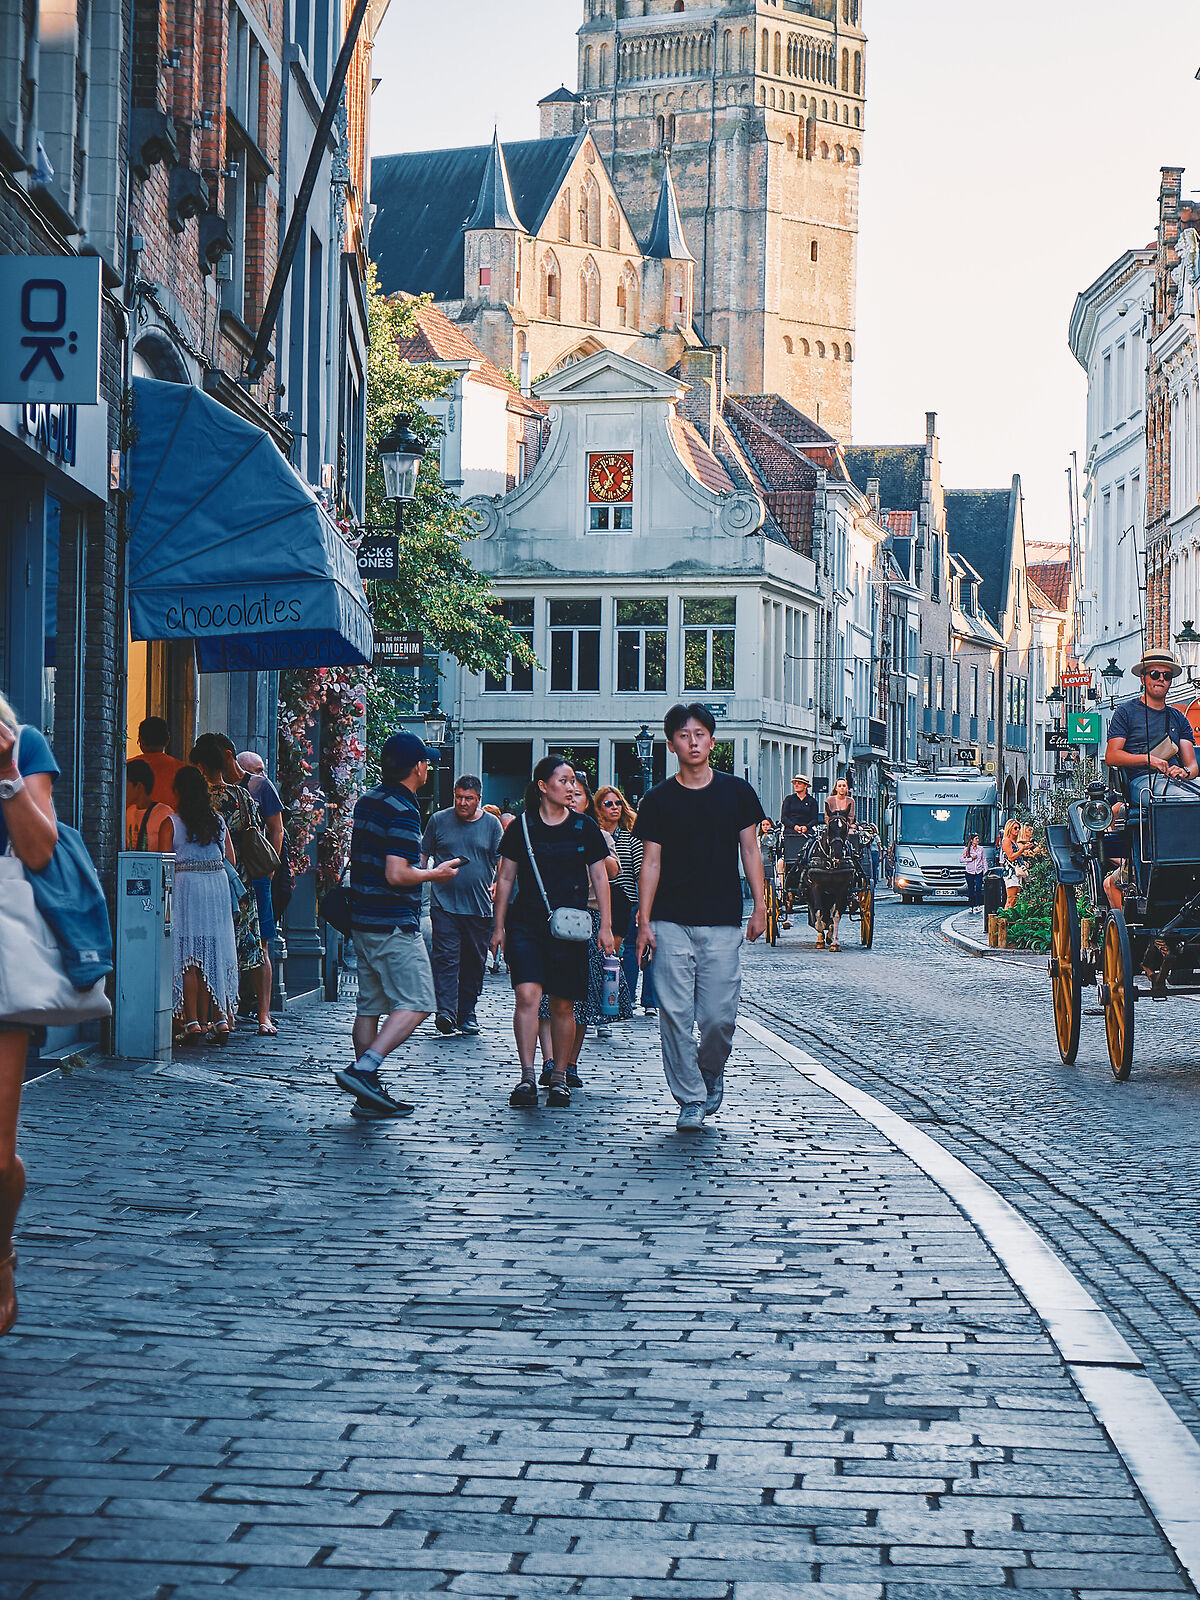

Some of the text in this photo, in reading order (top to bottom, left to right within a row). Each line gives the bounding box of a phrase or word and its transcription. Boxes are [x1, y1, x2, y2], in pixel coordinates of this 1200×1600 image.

[357, 557, 394, 568] ONES
[166, 592, 302, 630] chocolates
[1048, 734, 1068, 744] Eta
